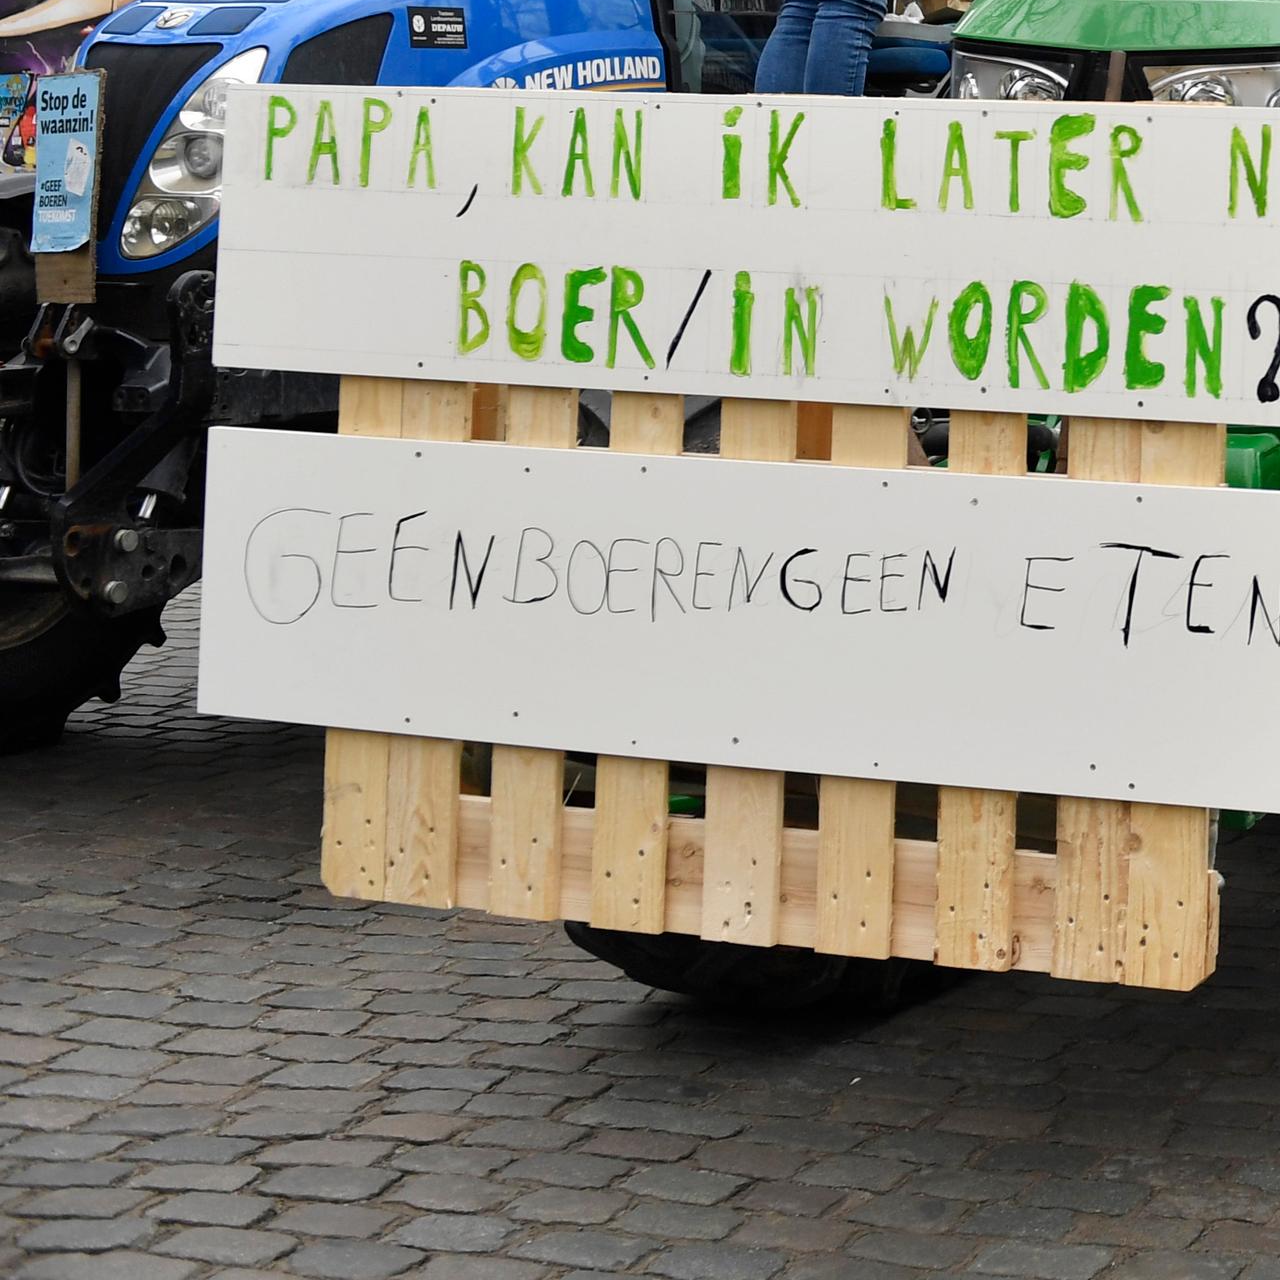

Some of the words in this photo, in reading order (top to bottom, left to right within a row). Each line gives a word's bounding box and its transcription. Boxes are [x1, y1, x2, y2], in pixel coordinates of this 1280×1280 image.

[525, 64, 573, 90] NEW
[577, 56, 661, 86] HOLLAND
[41, 89, 69, 114] Stop
[72, 87, 87, 109] de
[41, 109, 93, 135] waanzin!
[511, 106, 643, 201] KAN
[880, 112, 1144, 223] LATER
[40, 179, 62, 193] #GEEF
[39, 194, 67, 208] BOEREN
